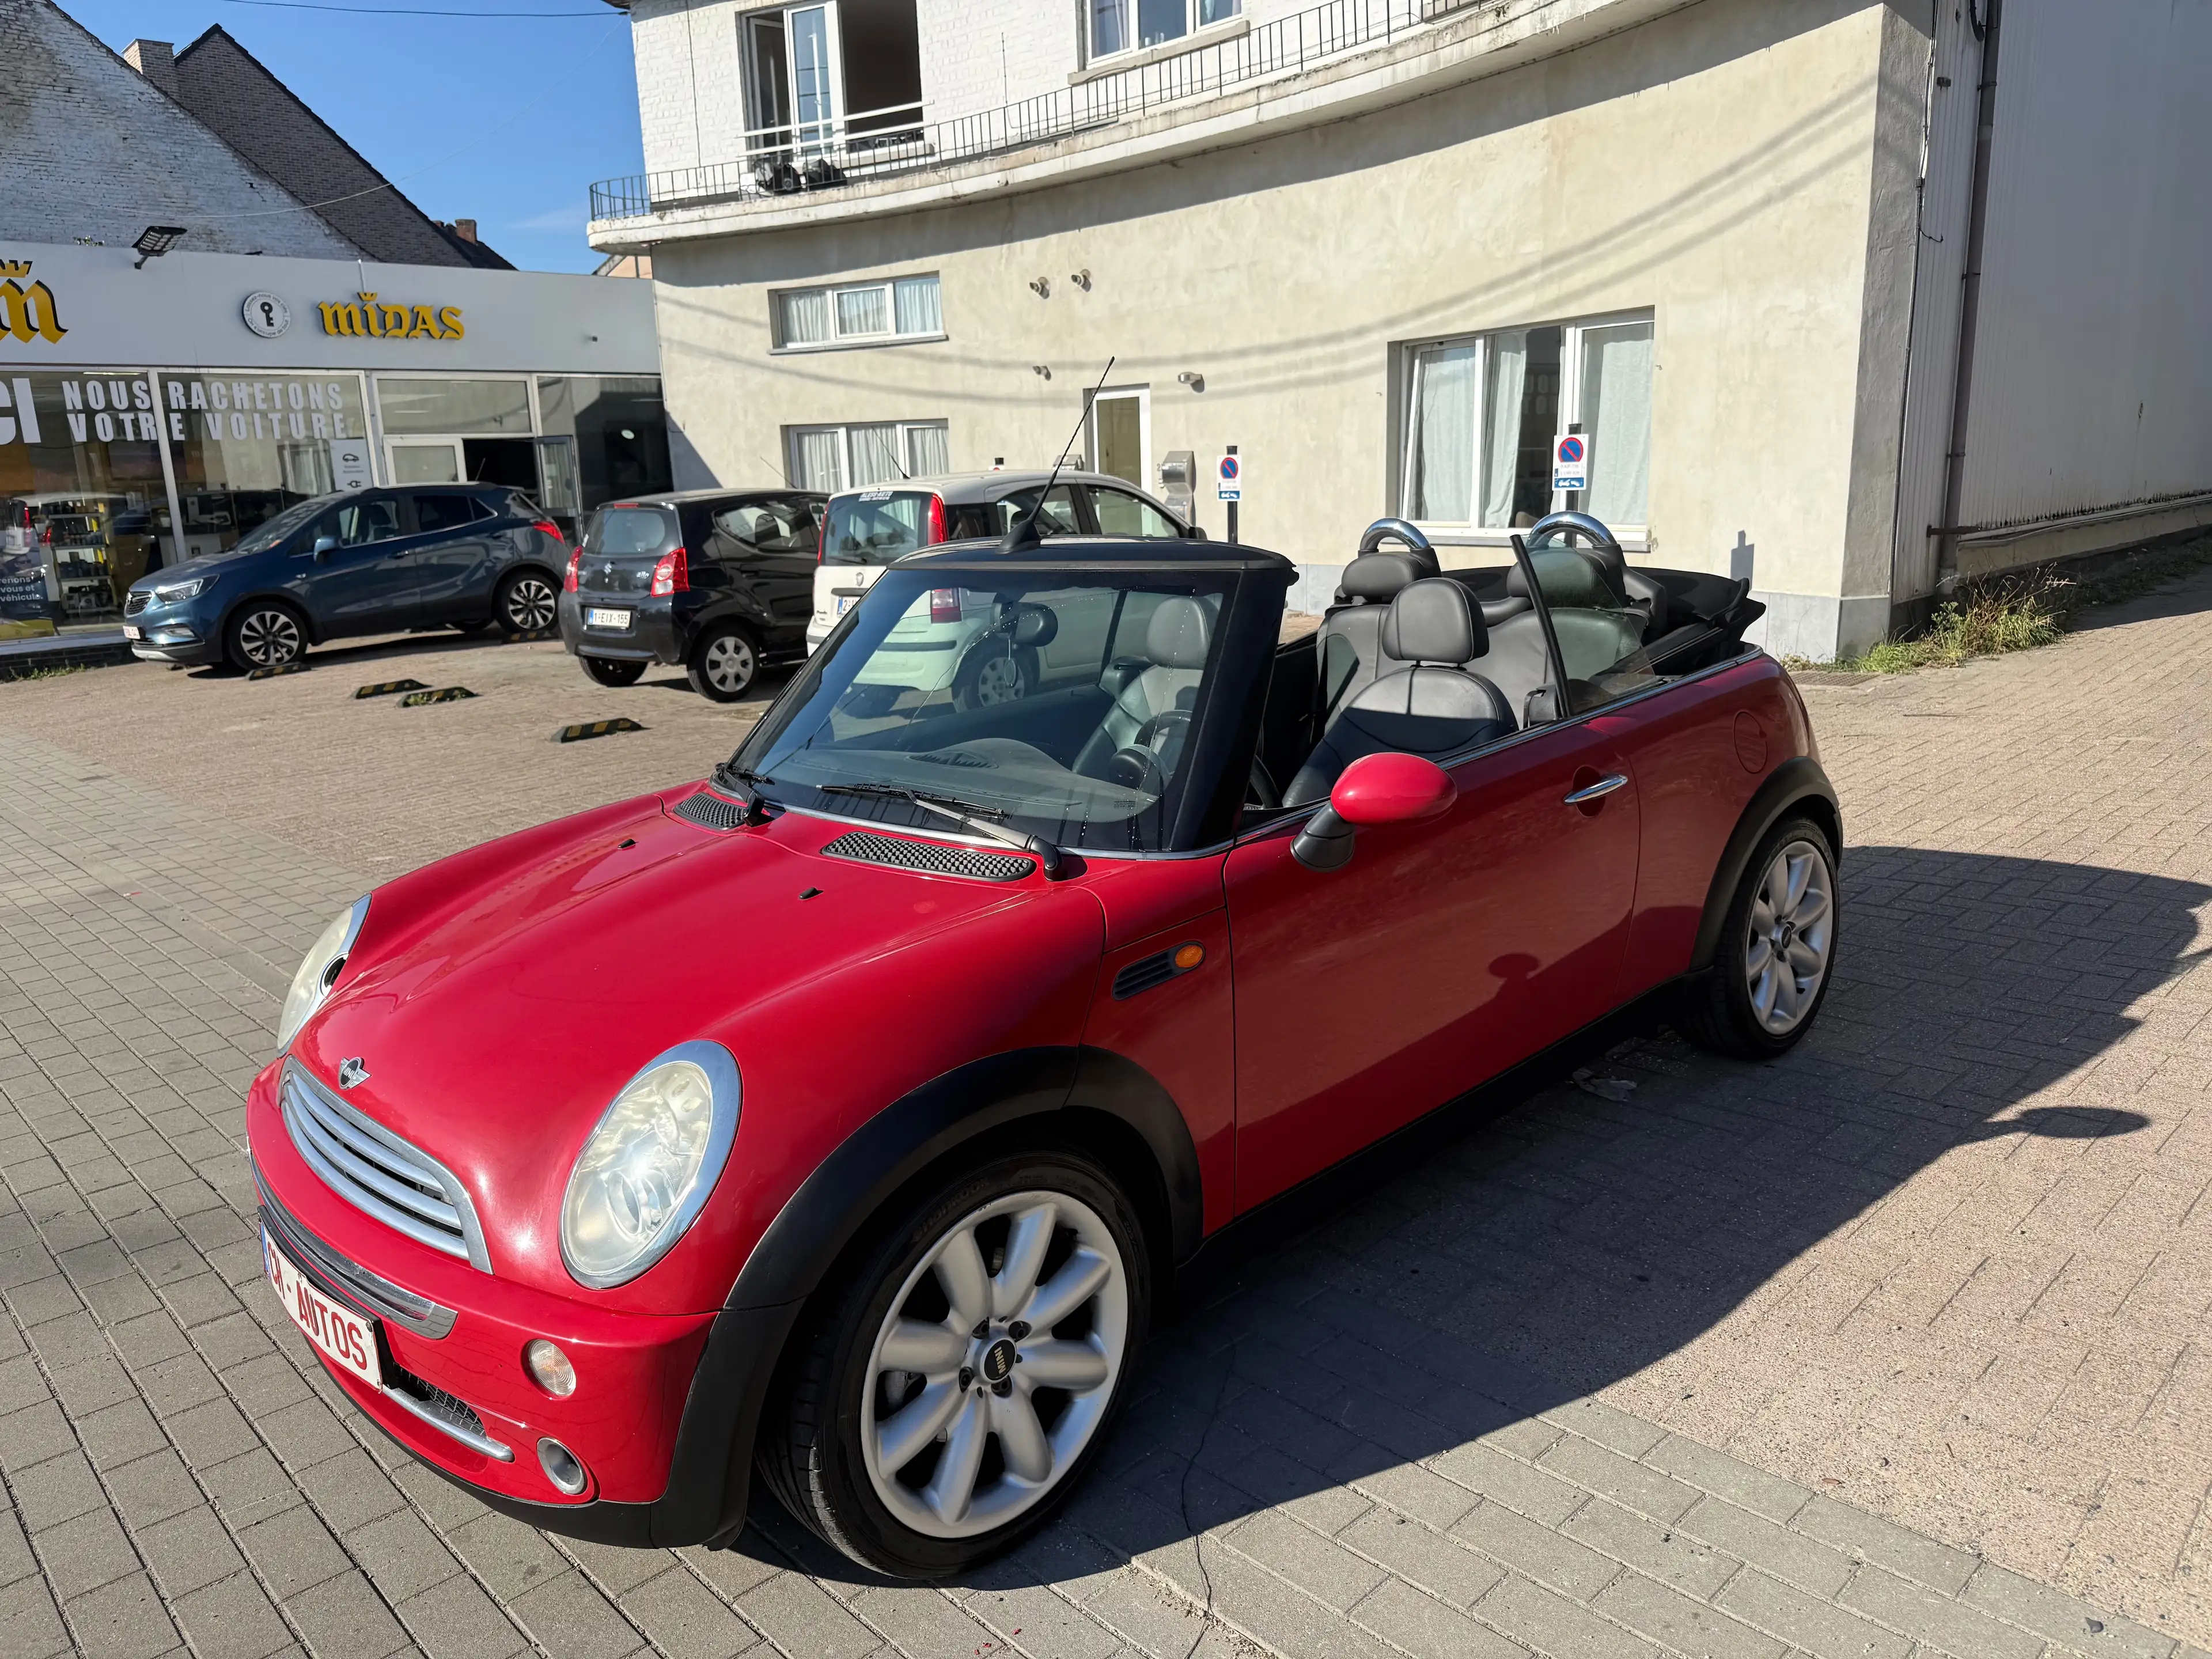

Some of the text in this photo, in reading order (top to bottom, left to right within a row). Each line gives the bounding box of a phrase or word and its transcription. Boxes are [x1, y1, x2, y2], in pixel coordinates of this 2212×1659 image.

[62, 380, 343, 411] NOUS RACHETONS
[66, 412, 347, 443] VOTRE VOITURE
[994, 1346, 1007, 1375] MINI
